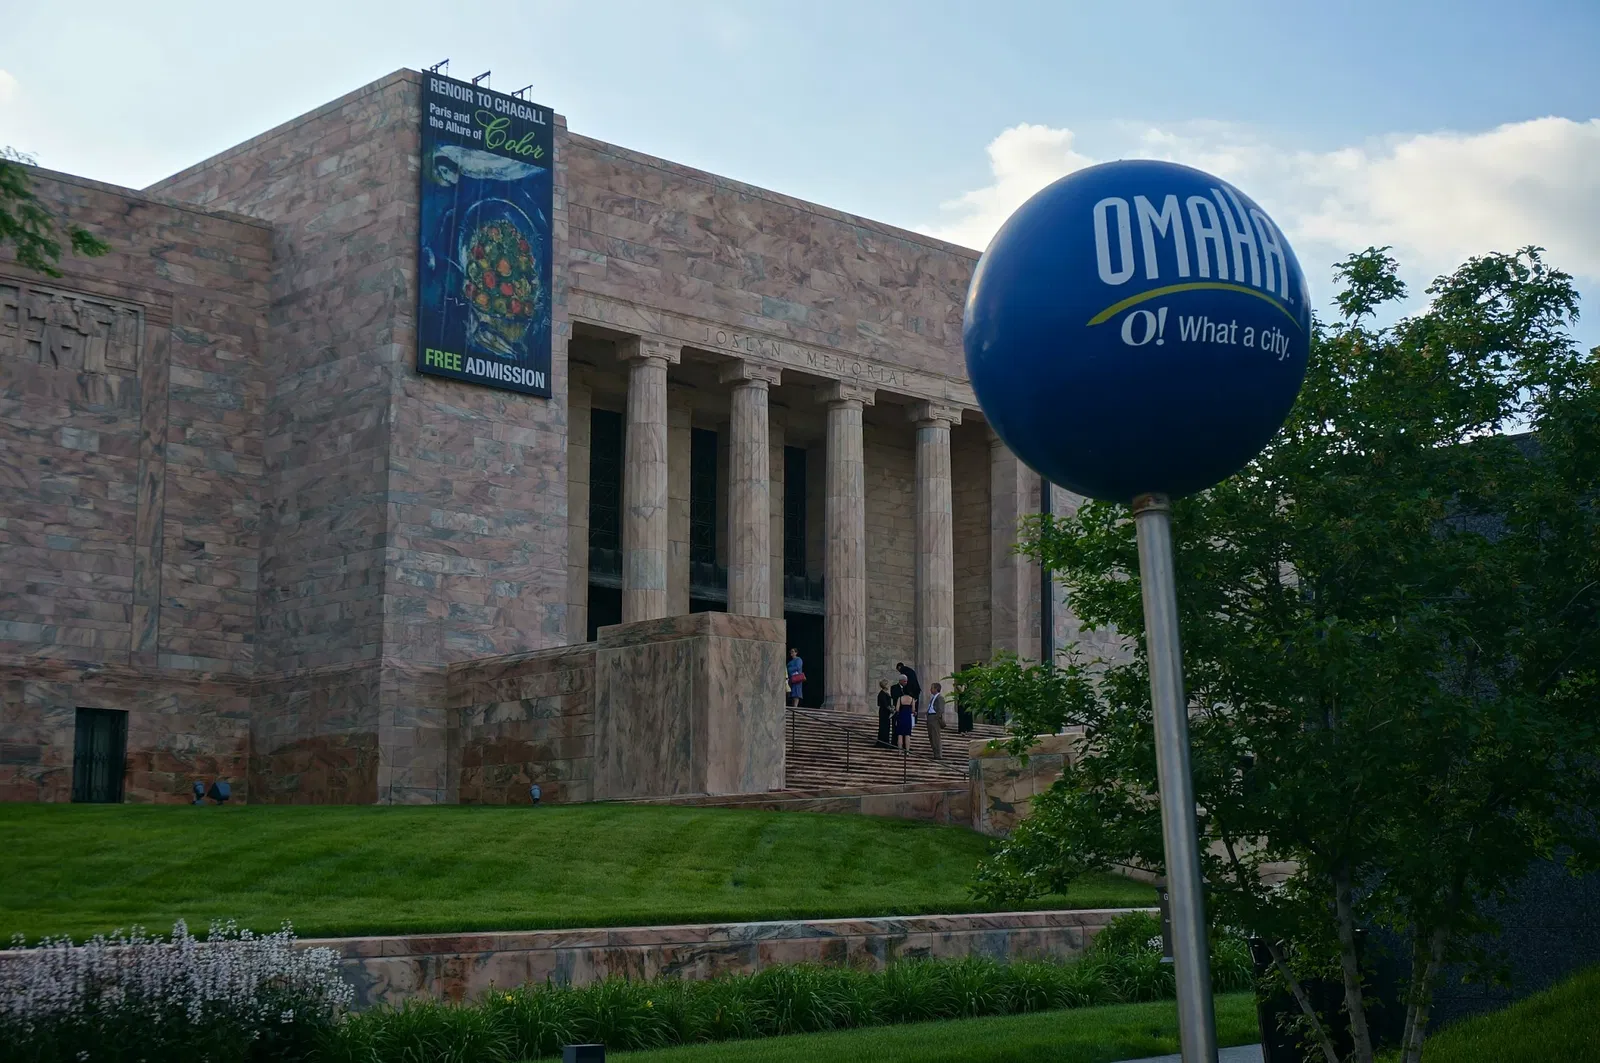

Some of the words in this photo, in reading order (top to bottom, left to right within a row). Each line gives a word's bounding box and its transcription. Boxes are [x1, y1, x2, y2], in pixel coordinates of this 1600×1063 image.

[429, 103, 452, 118] Paris
[453, 110, 470, 124] and
[430, 78, 473, 103] RENOIR
[476, 91, 492, 109] TO
[494, 98, 546, 125] CHAGALL
[429, 115, 444, 129] the
[445, 120, 471, 138] Allure
[473, 129, 482, 140] of
[474, 109, 545, 159] Color
[1093, 184, 1289, 301] OMAHA
[703, 327, 782, 357] JOSLYN
[806, 351, 910, 387] MEMORIAL
[1121, 306, 1168, 346] O!
[1179, 315, 1238, 345] What
[1243, 326, 1254, 347] a
[1261, 326, 1290, 361] city.
[425, 348, 461, 371] FREE
[465, 357, 545, 389] ADMISSION
